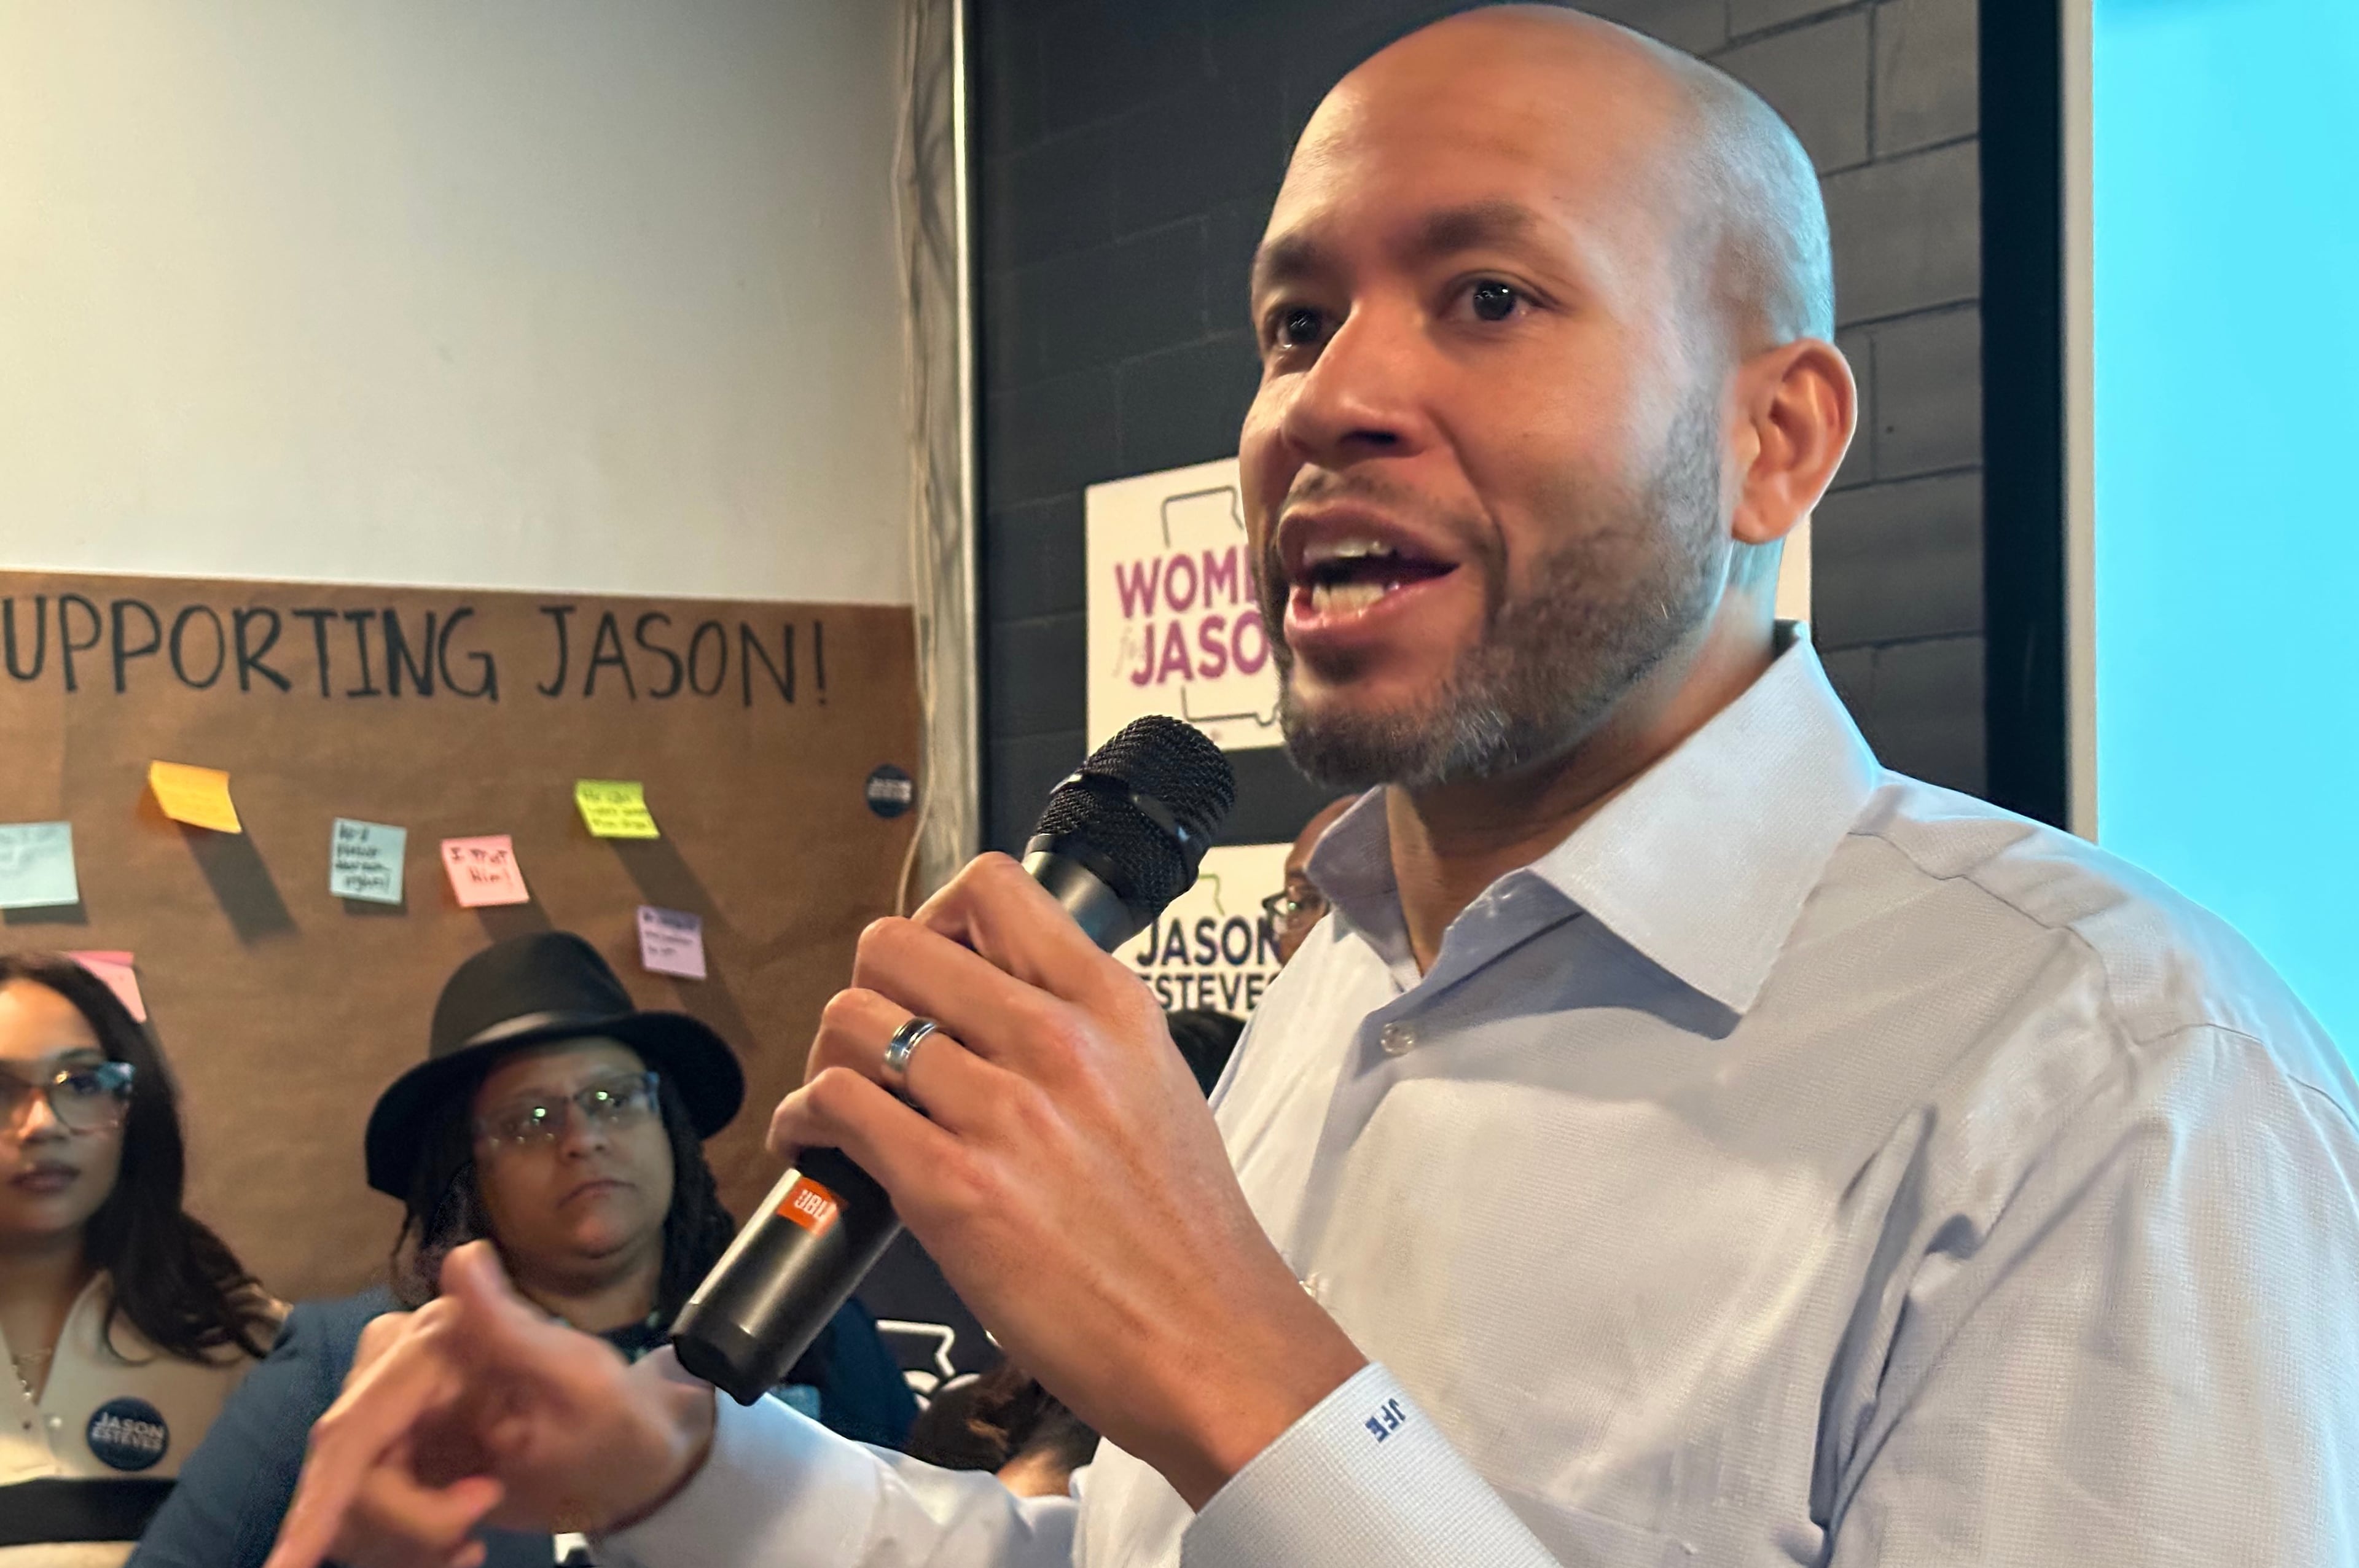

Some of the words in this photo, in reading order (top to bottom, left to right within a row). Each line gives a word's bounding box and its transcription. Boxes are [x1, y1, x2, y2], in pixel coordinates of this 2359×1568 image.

[536, 604, 827, 708] JASON!
[94, 1411, 165, 1439] JASON
[1365, 1398, 1406, 1443] JFE
